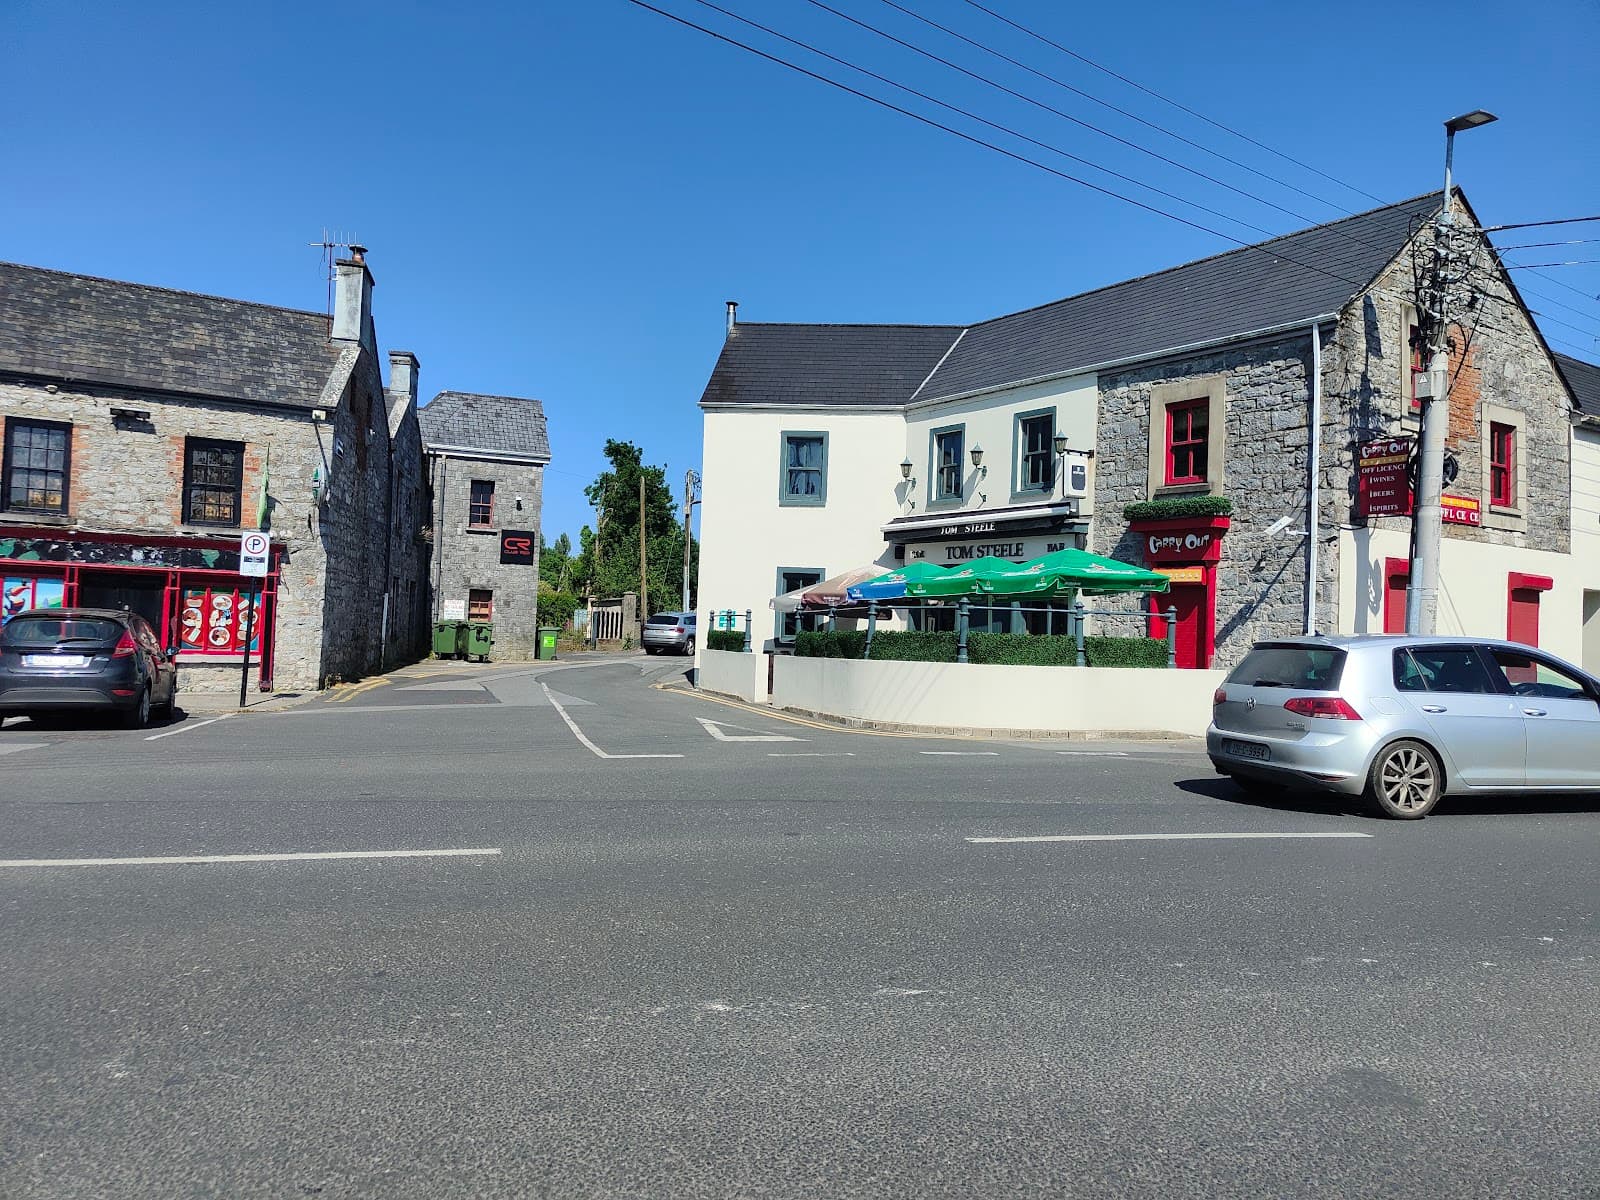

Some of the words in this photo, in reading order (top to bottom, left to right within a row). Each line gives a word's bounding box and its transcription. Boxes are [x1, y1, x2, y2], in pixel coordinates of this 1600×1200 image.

[1376, 464, 1406, 472] LICENCE
[1373, 489, 1396, 497] BEERS
[940, 527, 958, 535] TOM
[964, 522, 996, 533] STEELE
[1185, 534, 1209, 549] OUT
[946, 546, 974, 560] TOM
[977, 543, 1024, 559] STEELE
